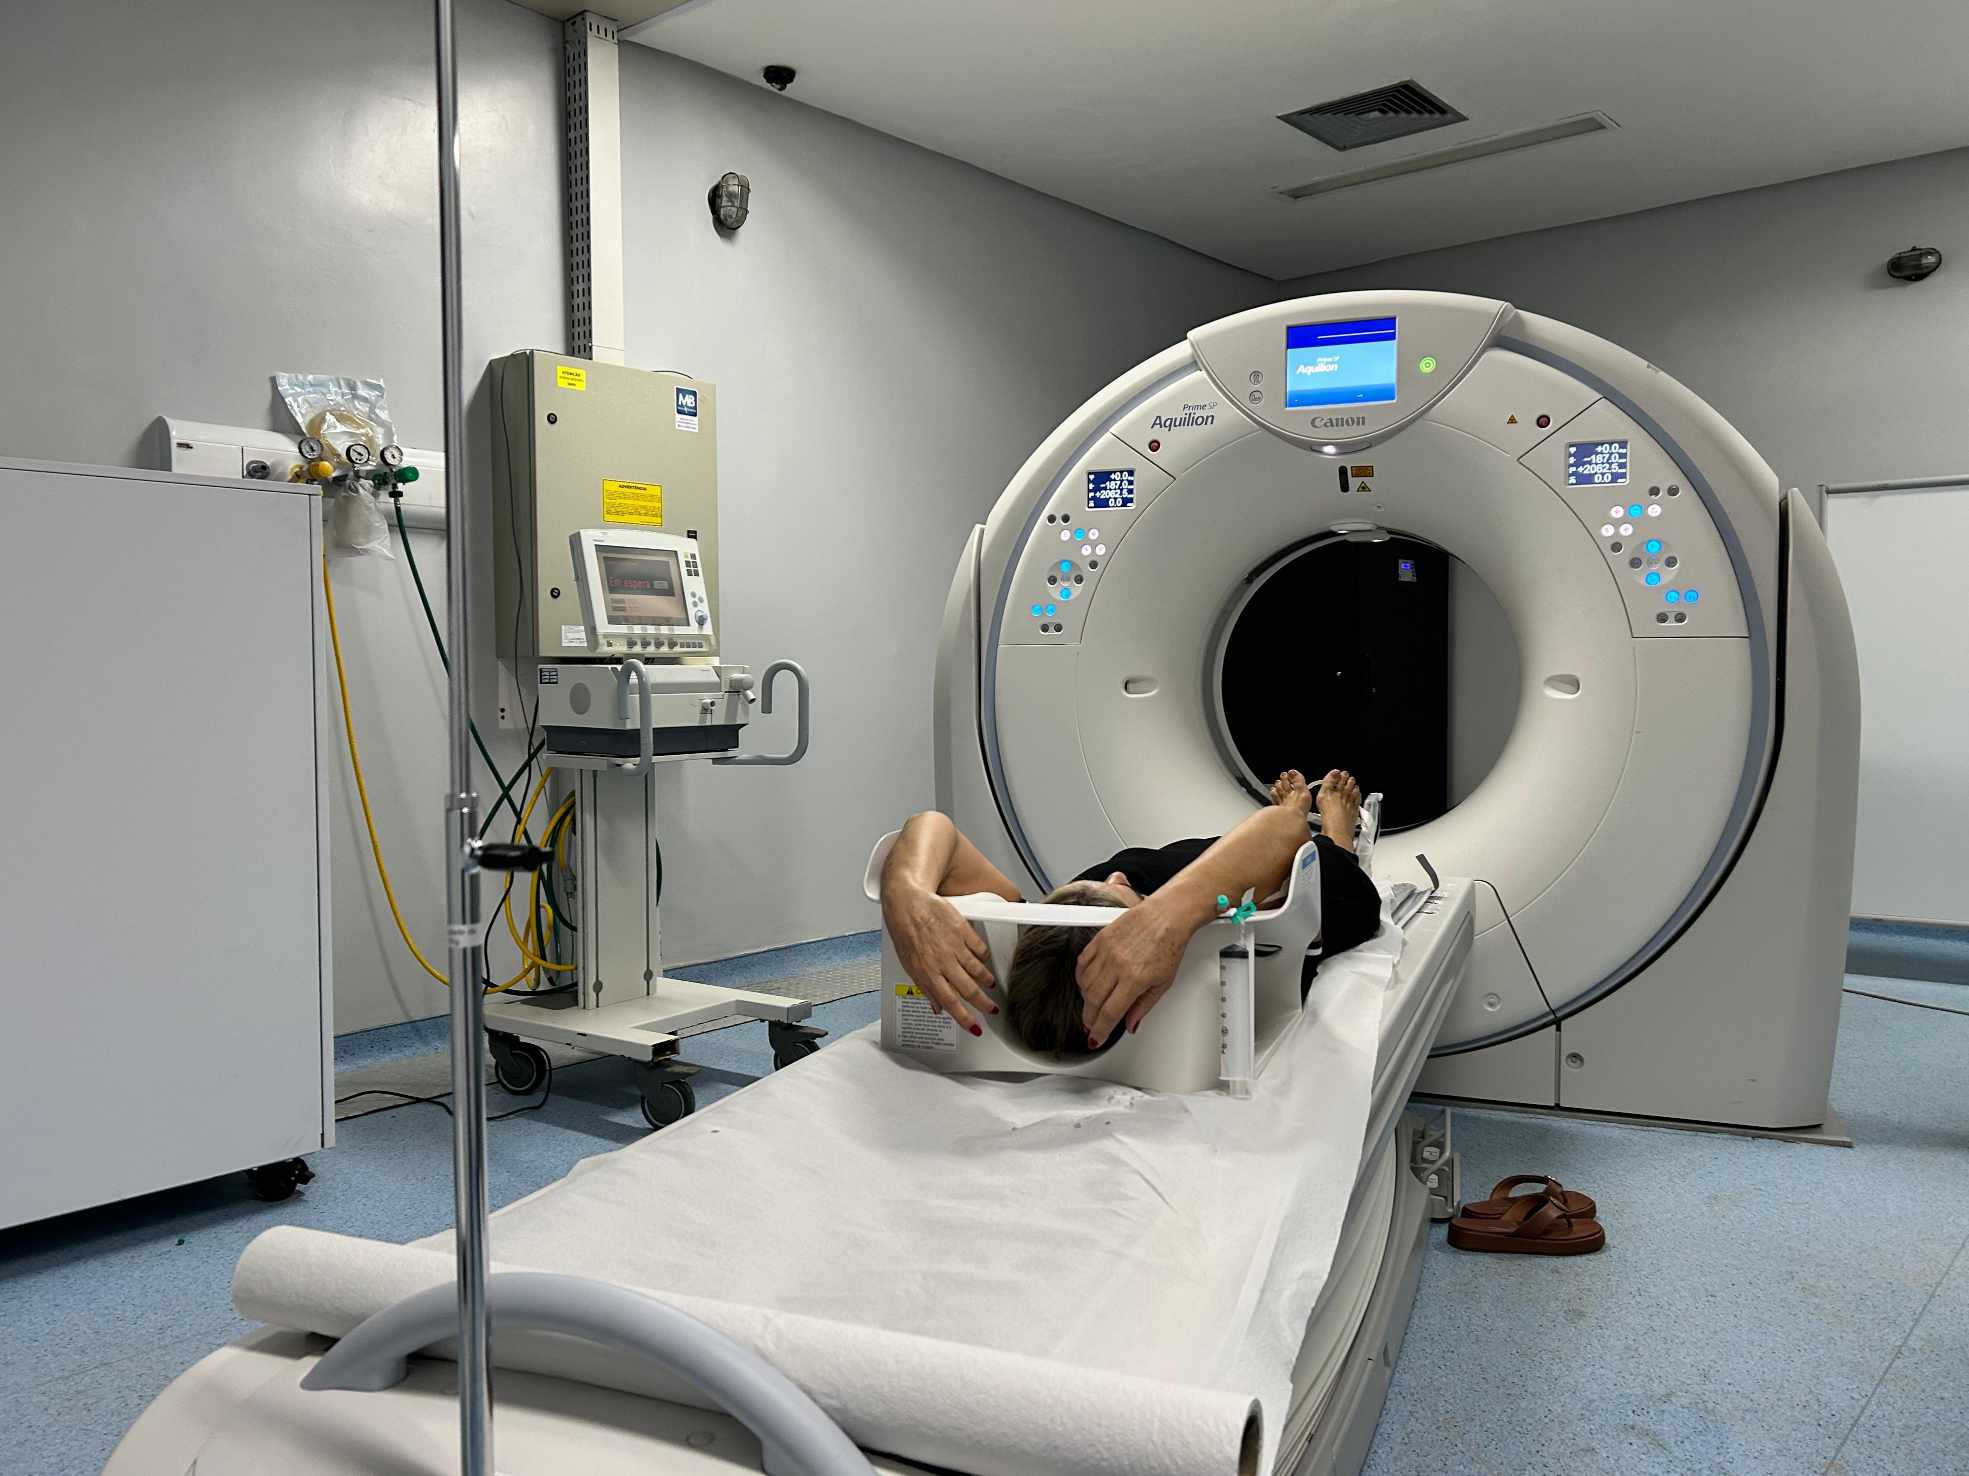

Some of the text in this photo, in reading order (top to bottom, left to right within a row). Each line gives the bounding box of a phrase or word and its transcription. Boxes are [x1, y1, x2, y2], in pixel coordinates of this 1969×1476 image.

[1296, 364, 1338, 375] Aquilion
[678, 393, 696, 407] MB
[1183, 403, 1206, 411] Prime
[1150, 411, 1215, 431] Aquilion
[1310, 416, 1366, 428] Canon
[1594, 473, 1611, 483] 0.0
[1109, 498, 1122, 507] 0.0
